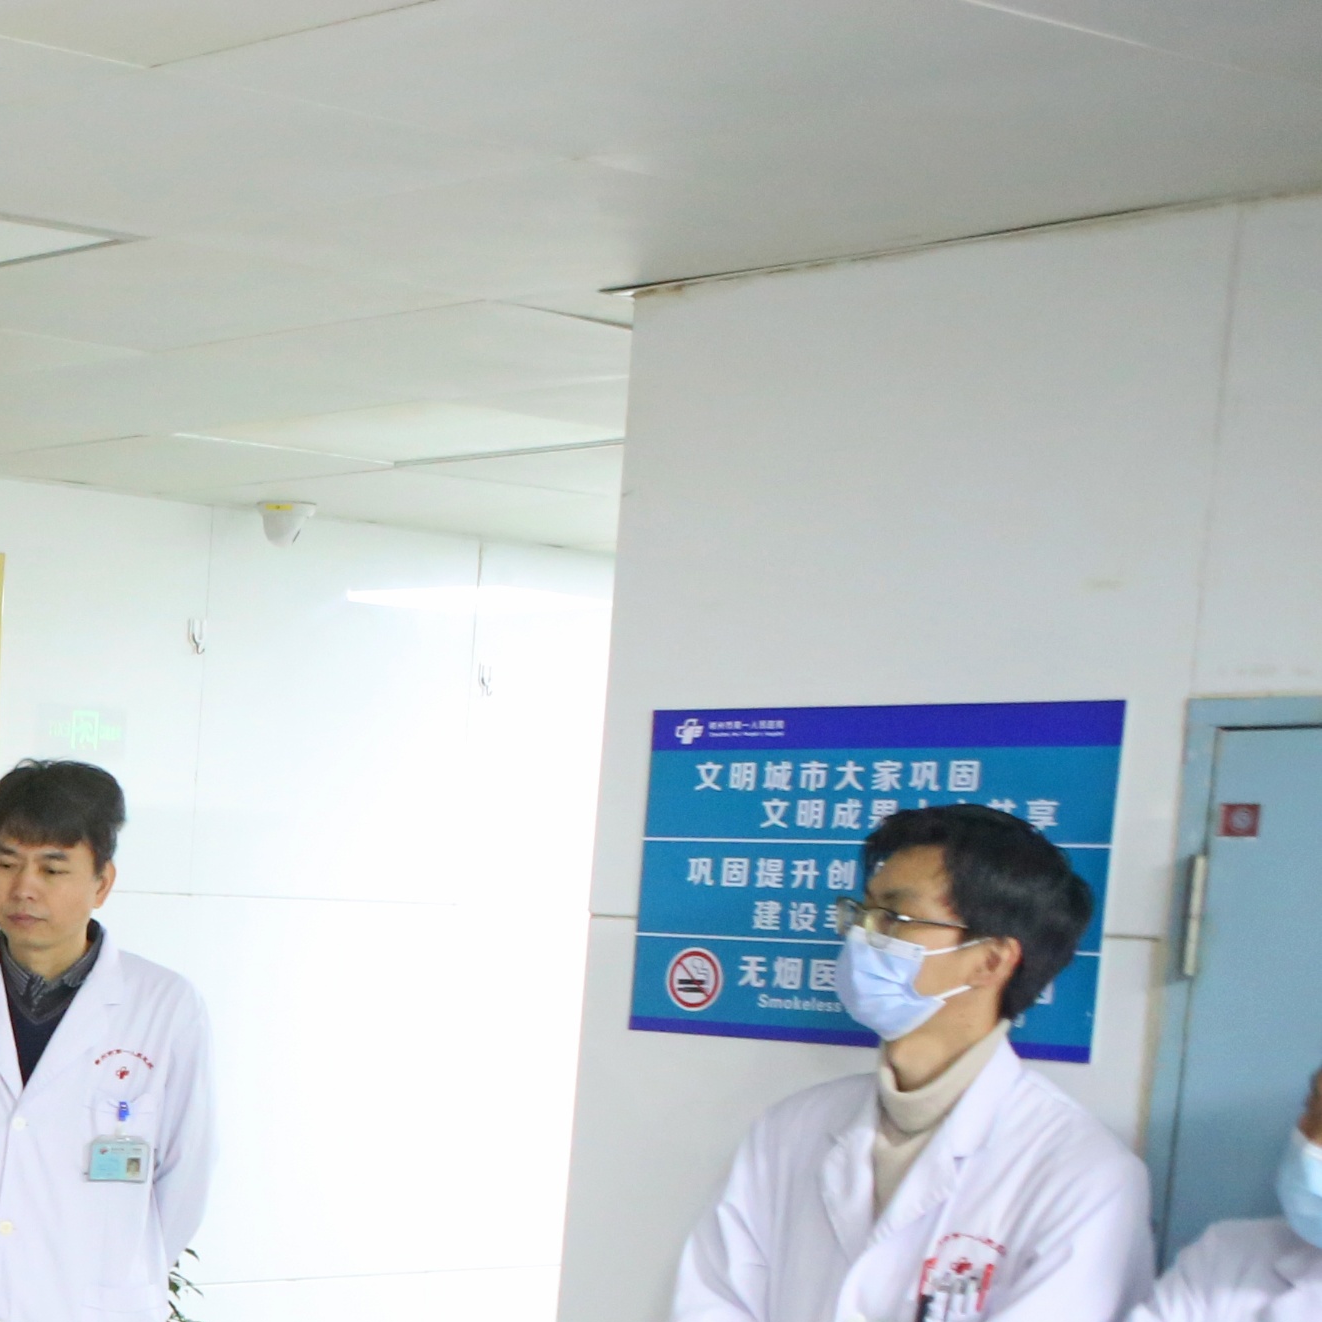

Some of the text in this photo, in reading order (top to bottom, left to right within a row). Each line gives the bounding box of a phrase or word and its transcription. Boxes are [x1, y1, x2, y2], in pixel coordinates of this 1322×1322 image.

[693, 759, 981, 793] 文明城市大家巩固
[760, 799, 1060, 830] 文明成果享
[758, 993, 842, 1013] Smokeless
